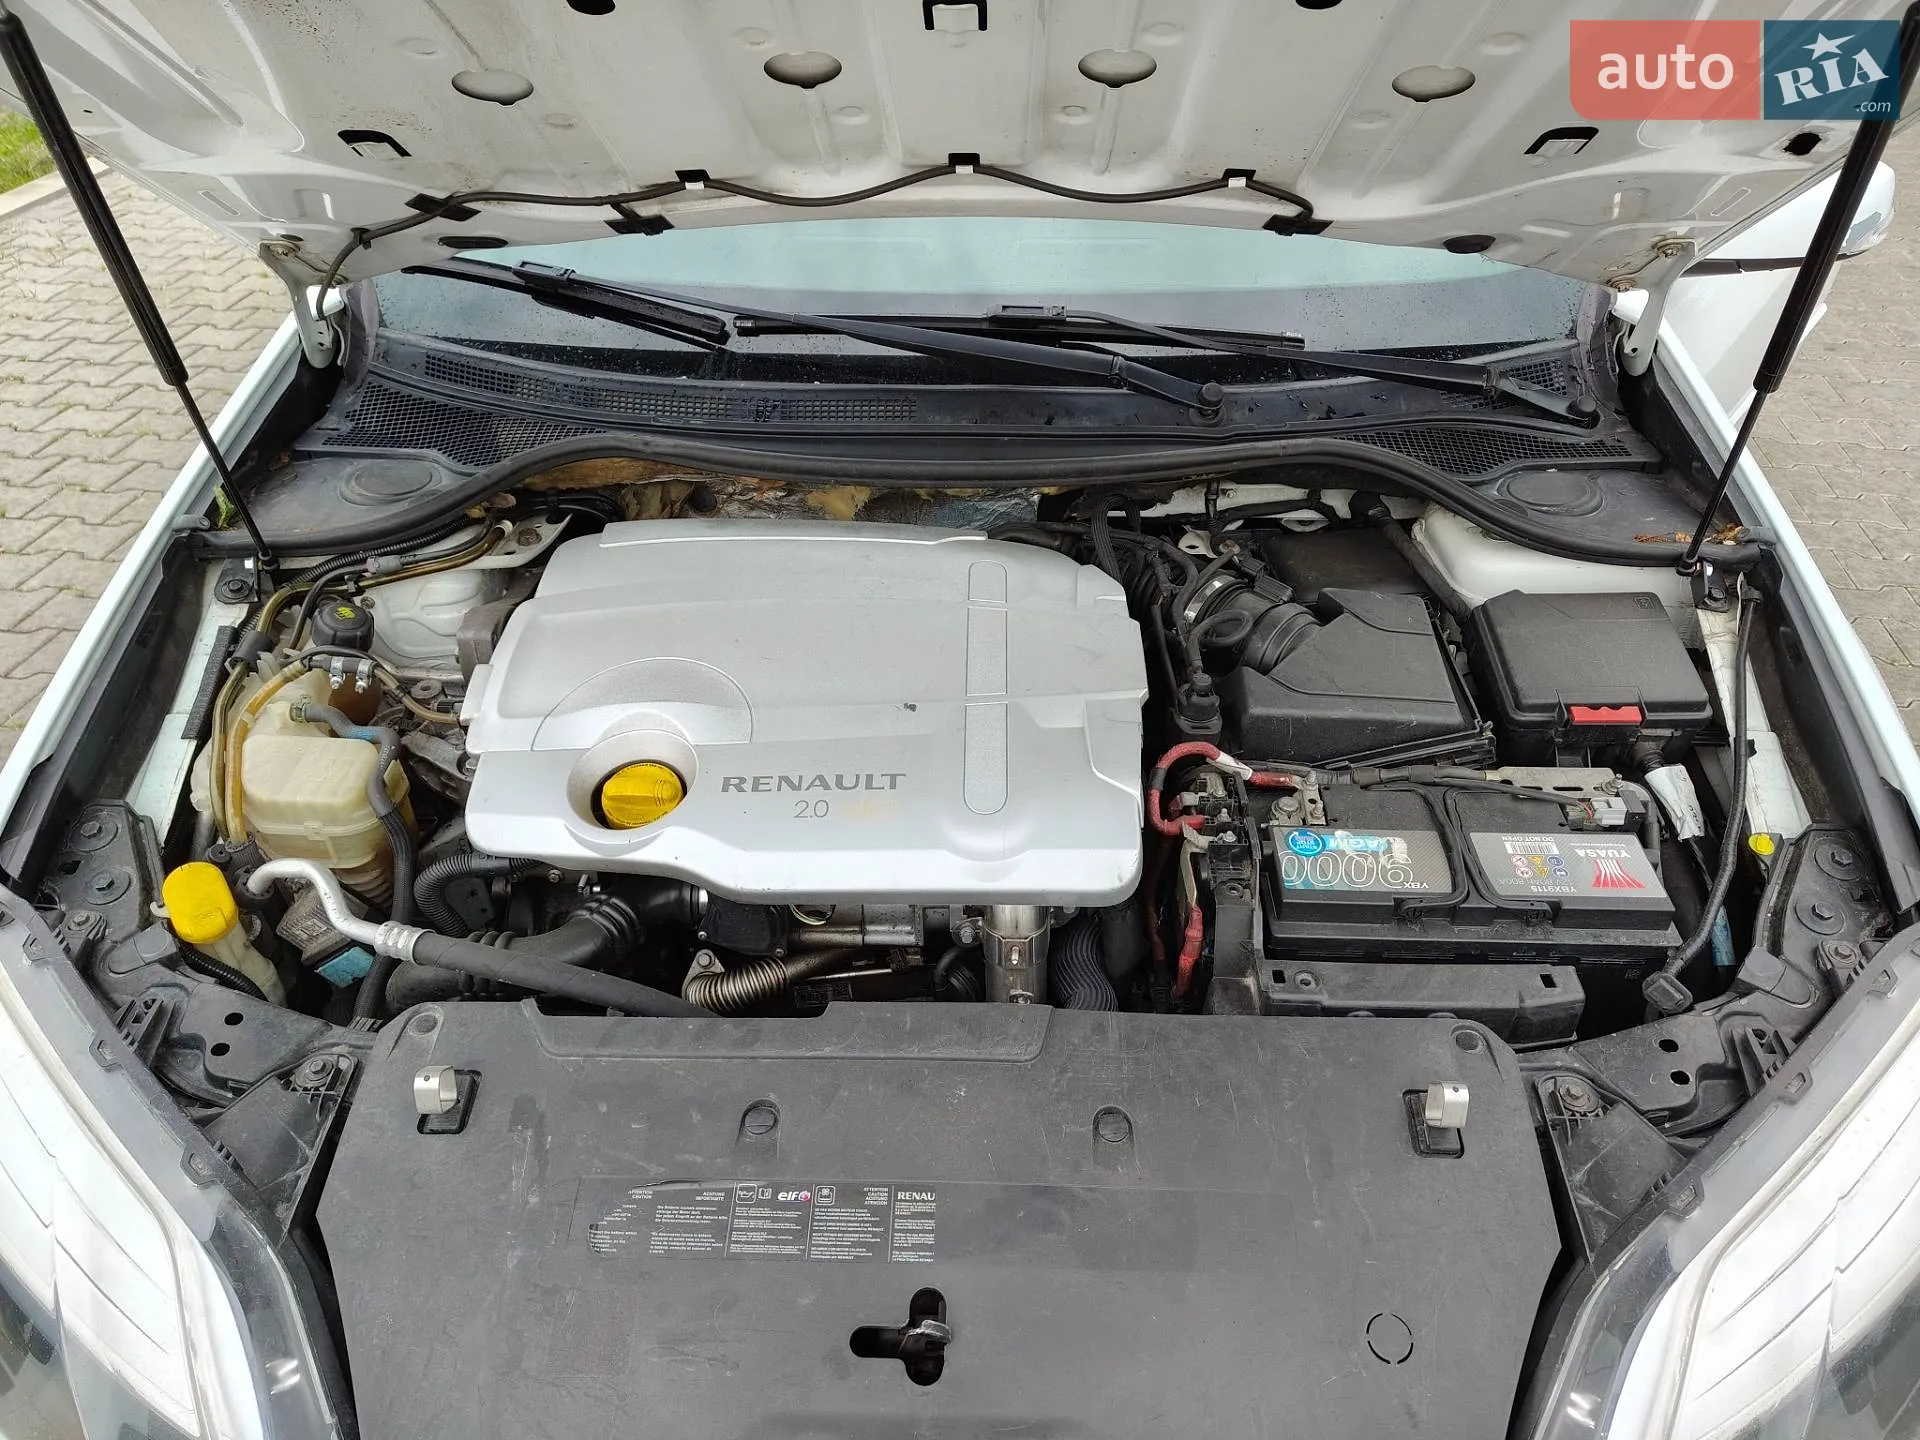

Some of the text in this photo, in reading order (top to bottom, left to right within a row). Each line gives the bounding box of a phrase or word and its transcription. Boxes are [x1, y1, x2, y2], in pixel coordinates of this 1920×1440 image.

[721, 773, 906, 793] RENAULT
[794, 799, 829, 819] 2.0
[1574, 848, 1631, 858] YUASA
[1402, 881, 1429, 889] YBX
[1530, 885, 1577, 893] YBX9115
